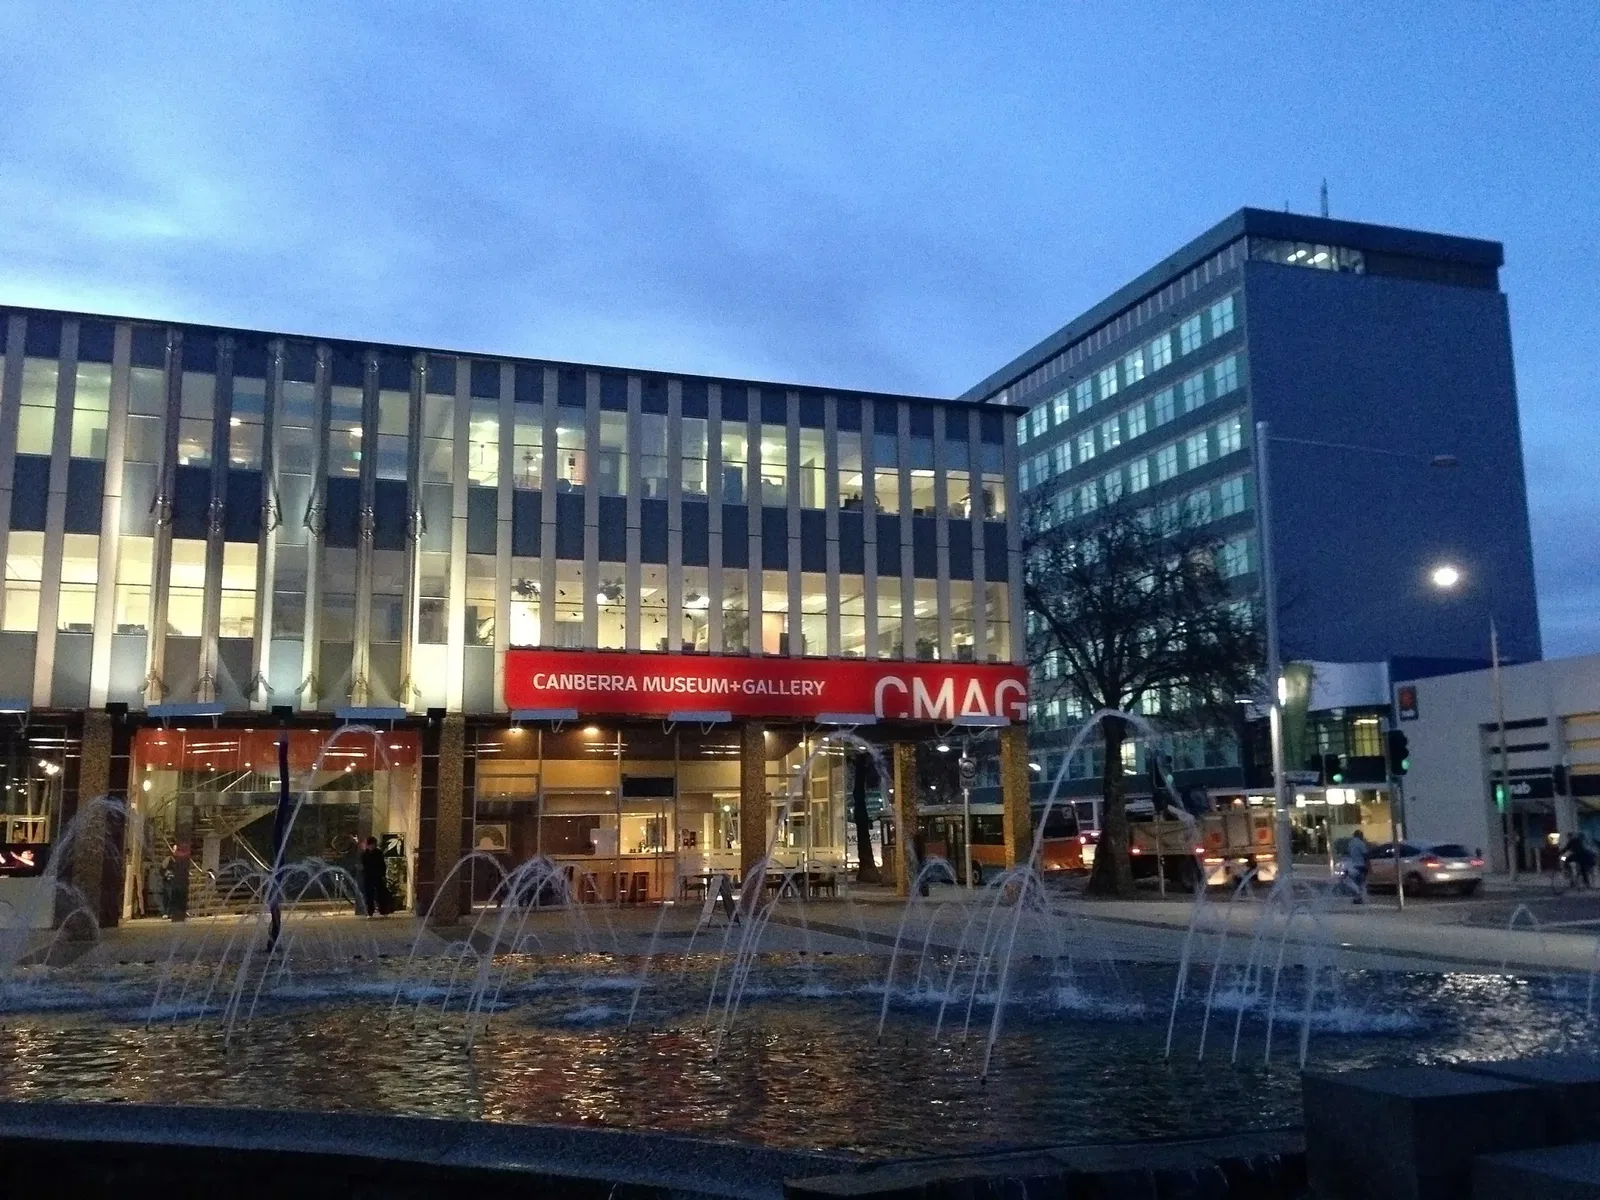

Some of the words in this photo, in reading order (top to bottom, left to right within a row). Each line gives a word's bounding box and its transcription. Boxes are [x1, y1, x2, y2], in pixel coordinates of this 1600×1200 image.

[533, 673, 638, 692] CANBERRA
[643, 676, 826, 696] MUSEUM+GALLERY
[874, 676, 1027, 721] CMAG
